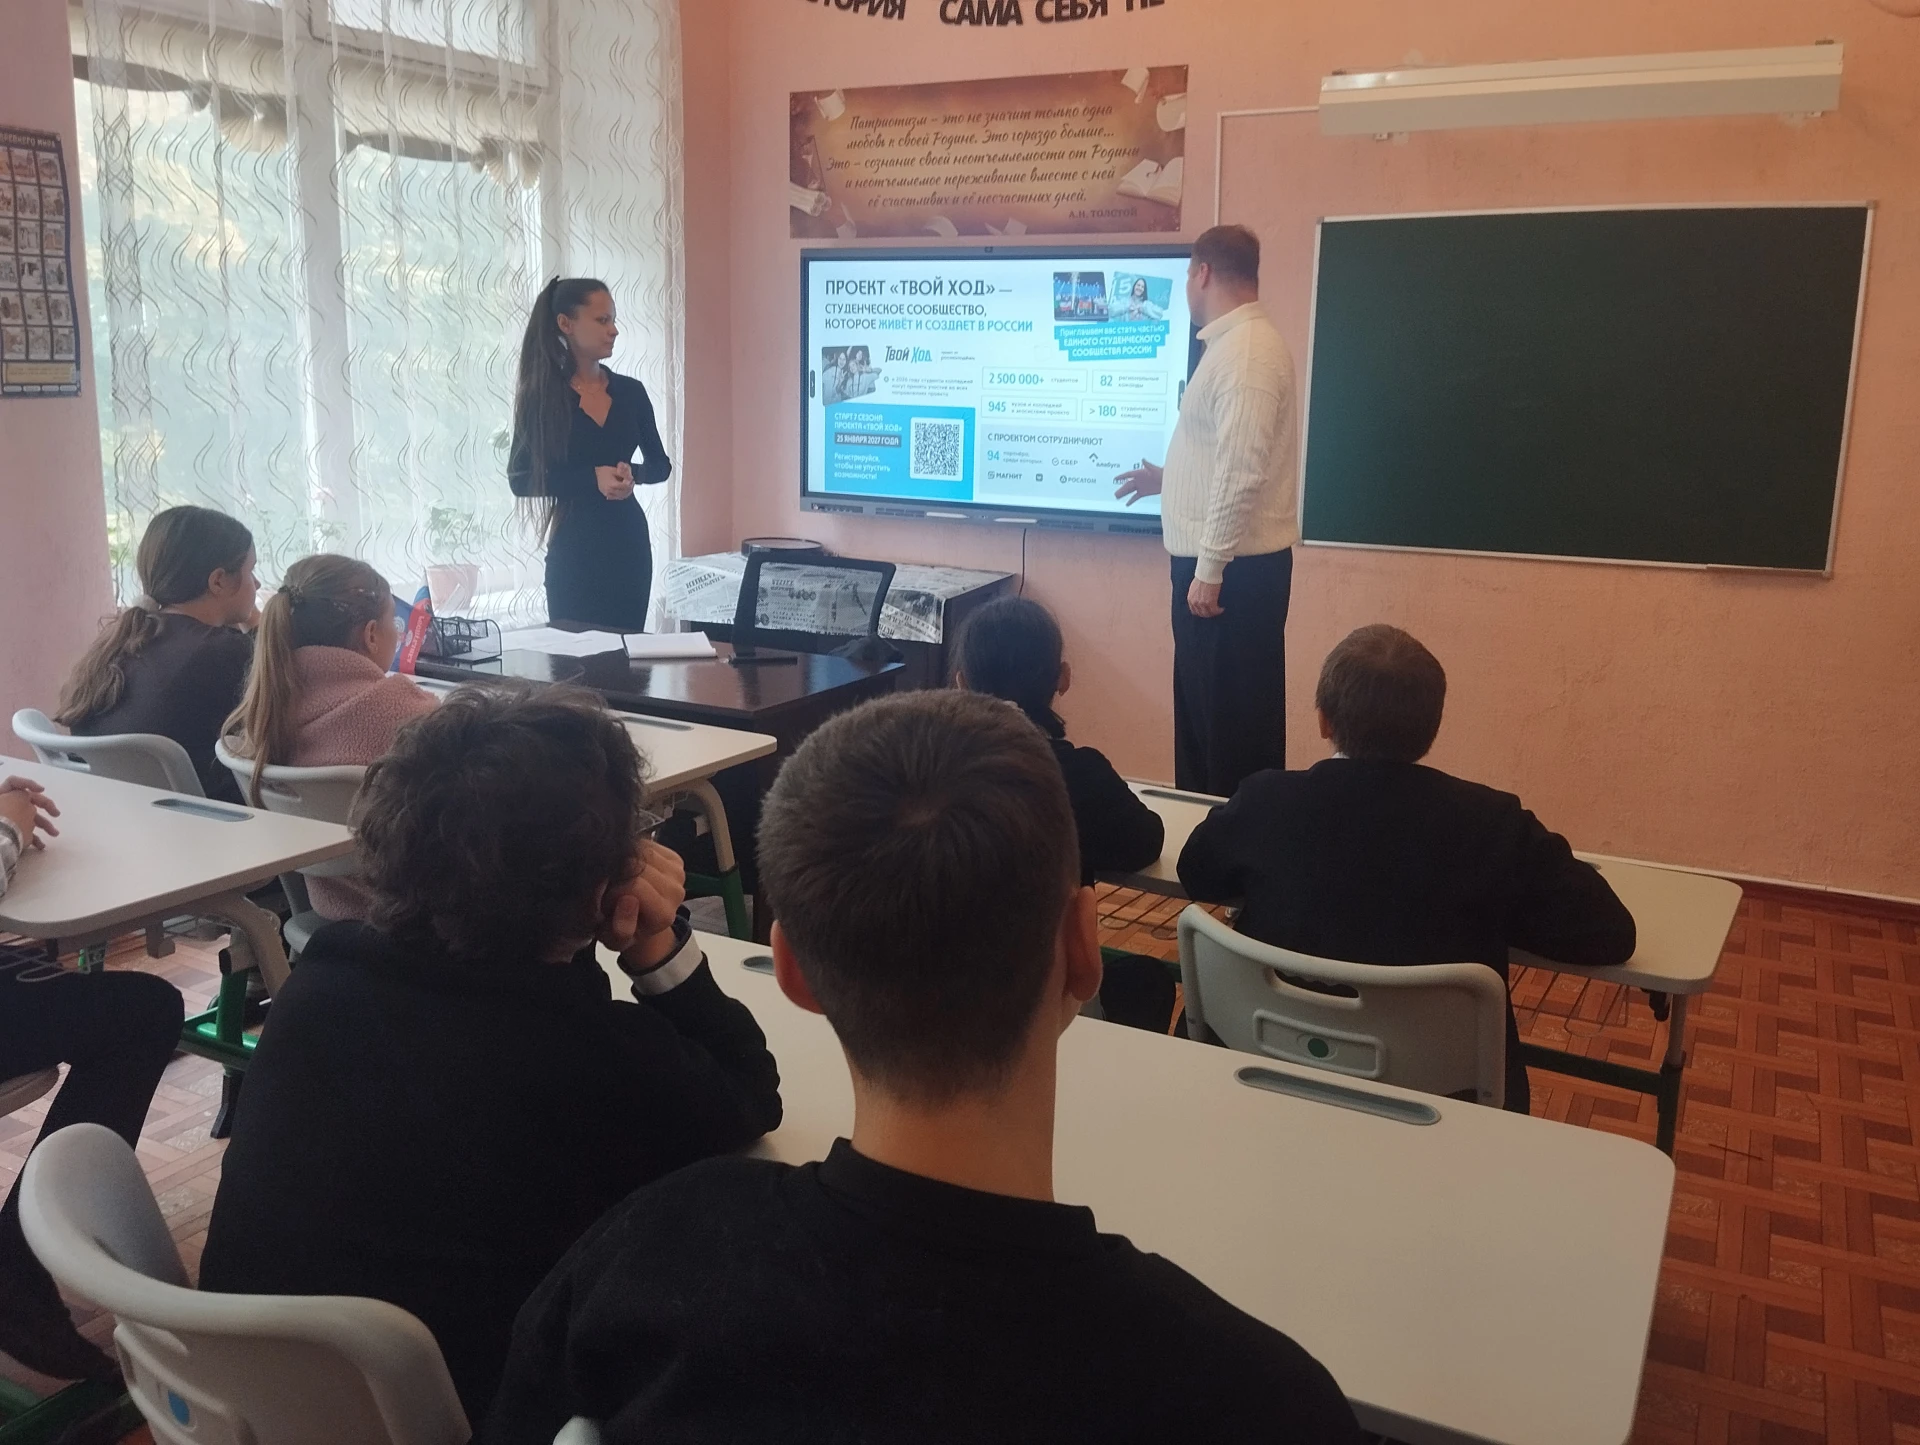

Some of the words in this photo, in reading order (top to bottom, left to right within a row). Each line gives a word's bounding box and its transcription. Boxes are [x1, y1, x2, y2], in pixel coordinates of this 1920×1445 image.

[940, 0, 1023, 26] САМА
[1035, 0, 1108, 23] СЕБЯ
[850, 116, 927, 132] Патриотизм
[943, 114, 964, 125] это
[967, 113, 981, 123] не
[984, 109, 1031, 128] значит
[1034, 106, 1079, 119] только
[1083, 105, 1113, 122] одна
[846, 133, 886, 149] любовь
[898, 131, 929, 147] своей
[933, 131, 978, 150] Родине.
[982, 129, 1009, 143] Это
[1012, 129, 1057, 146] гораздо
[1060, 123, 1114, 138] больше...
[826, 157, 850, 171] Это
[864, 157, 916, 173] сознание
[919, 151, 950, 166] своей
[953, 150, 1065, 165] неотъемлемости
[1068, 149, 1087, 160] от
[1091, 144, 1140, 164] Родины
[845, 179, 852, 189] и
[855, 176, 941, 189] неотъемлемое
[944, 168, 1026, 190] переживание
[1030, 166, 1079, 182] вместе
[1081, 171, 1089, 181] с
[1091, 165, 1116, 180] ней
[868, 194, 881, 208] её
[882, 191, 950, 207] счастливых
[952, 195, 960, 205] и
[962, 192, 976, 205] её
[977, 192, 1052, 205] несчастных
[1053, 188, 1087, 208] дней.
[1091, 208, 1138, 218] ТОЛСТОЙ
[825, 280, 886, 295] ПРОЕКТ
[890, 276, 943, 296] «ТВОЙ
[948, 280, 995, 296] ХОД»
[825, 303, 904, 315] СТУДЕНЧЕСКОЕ
[907, 304, 987, 317] СООБЩЕСТВО,
[825, 318, 877, 329] КОТОРОЕ
[878, 316, 913, 330] ЖИВЁТ
[915, 319, 922, 330] И
[978, 320, 985, 331] В
[987, 320, 1033, 332] РОССИИ
[1064, 337, 1099, 347] ЕДИНОГО
[1099, 334, 1161, 346] СТУДЕНЧЕСКОГО
[885, 346, 910, 363] Твой
[911, 346, 932, 364] Ход
[1072, 347, 1121, 357] СООБЩЕСТВА
[1122, 346, 1152, 355] РОССИИ
[989, 372, 995, 384] 2
[997, 373, 1016, 384] 500
[1018, 373, 1044, 385] 000+
[1100, 375, 1113, 387] 82
[988, 400, 1006, 412] 945
[1098, 405, 1117, 417] 180
[858, 413, 883, 421] СЕЗОНА
[834, 422, 862, 430] ПРОЕКТА
[844, 435, 867, 444] ЯНВАРЯ
[881, 437, 899, 445] ГОДА
[988, 433, 993, 441] С
[994, 433, 1036, 443] ПРОЕКТОМ
[1037, 435, 1103, 446] СОТРУДНИЧАЮТ
[987, 450, 1000, 461] 94
[996, 472, 1022, 480] МАГНИТ
